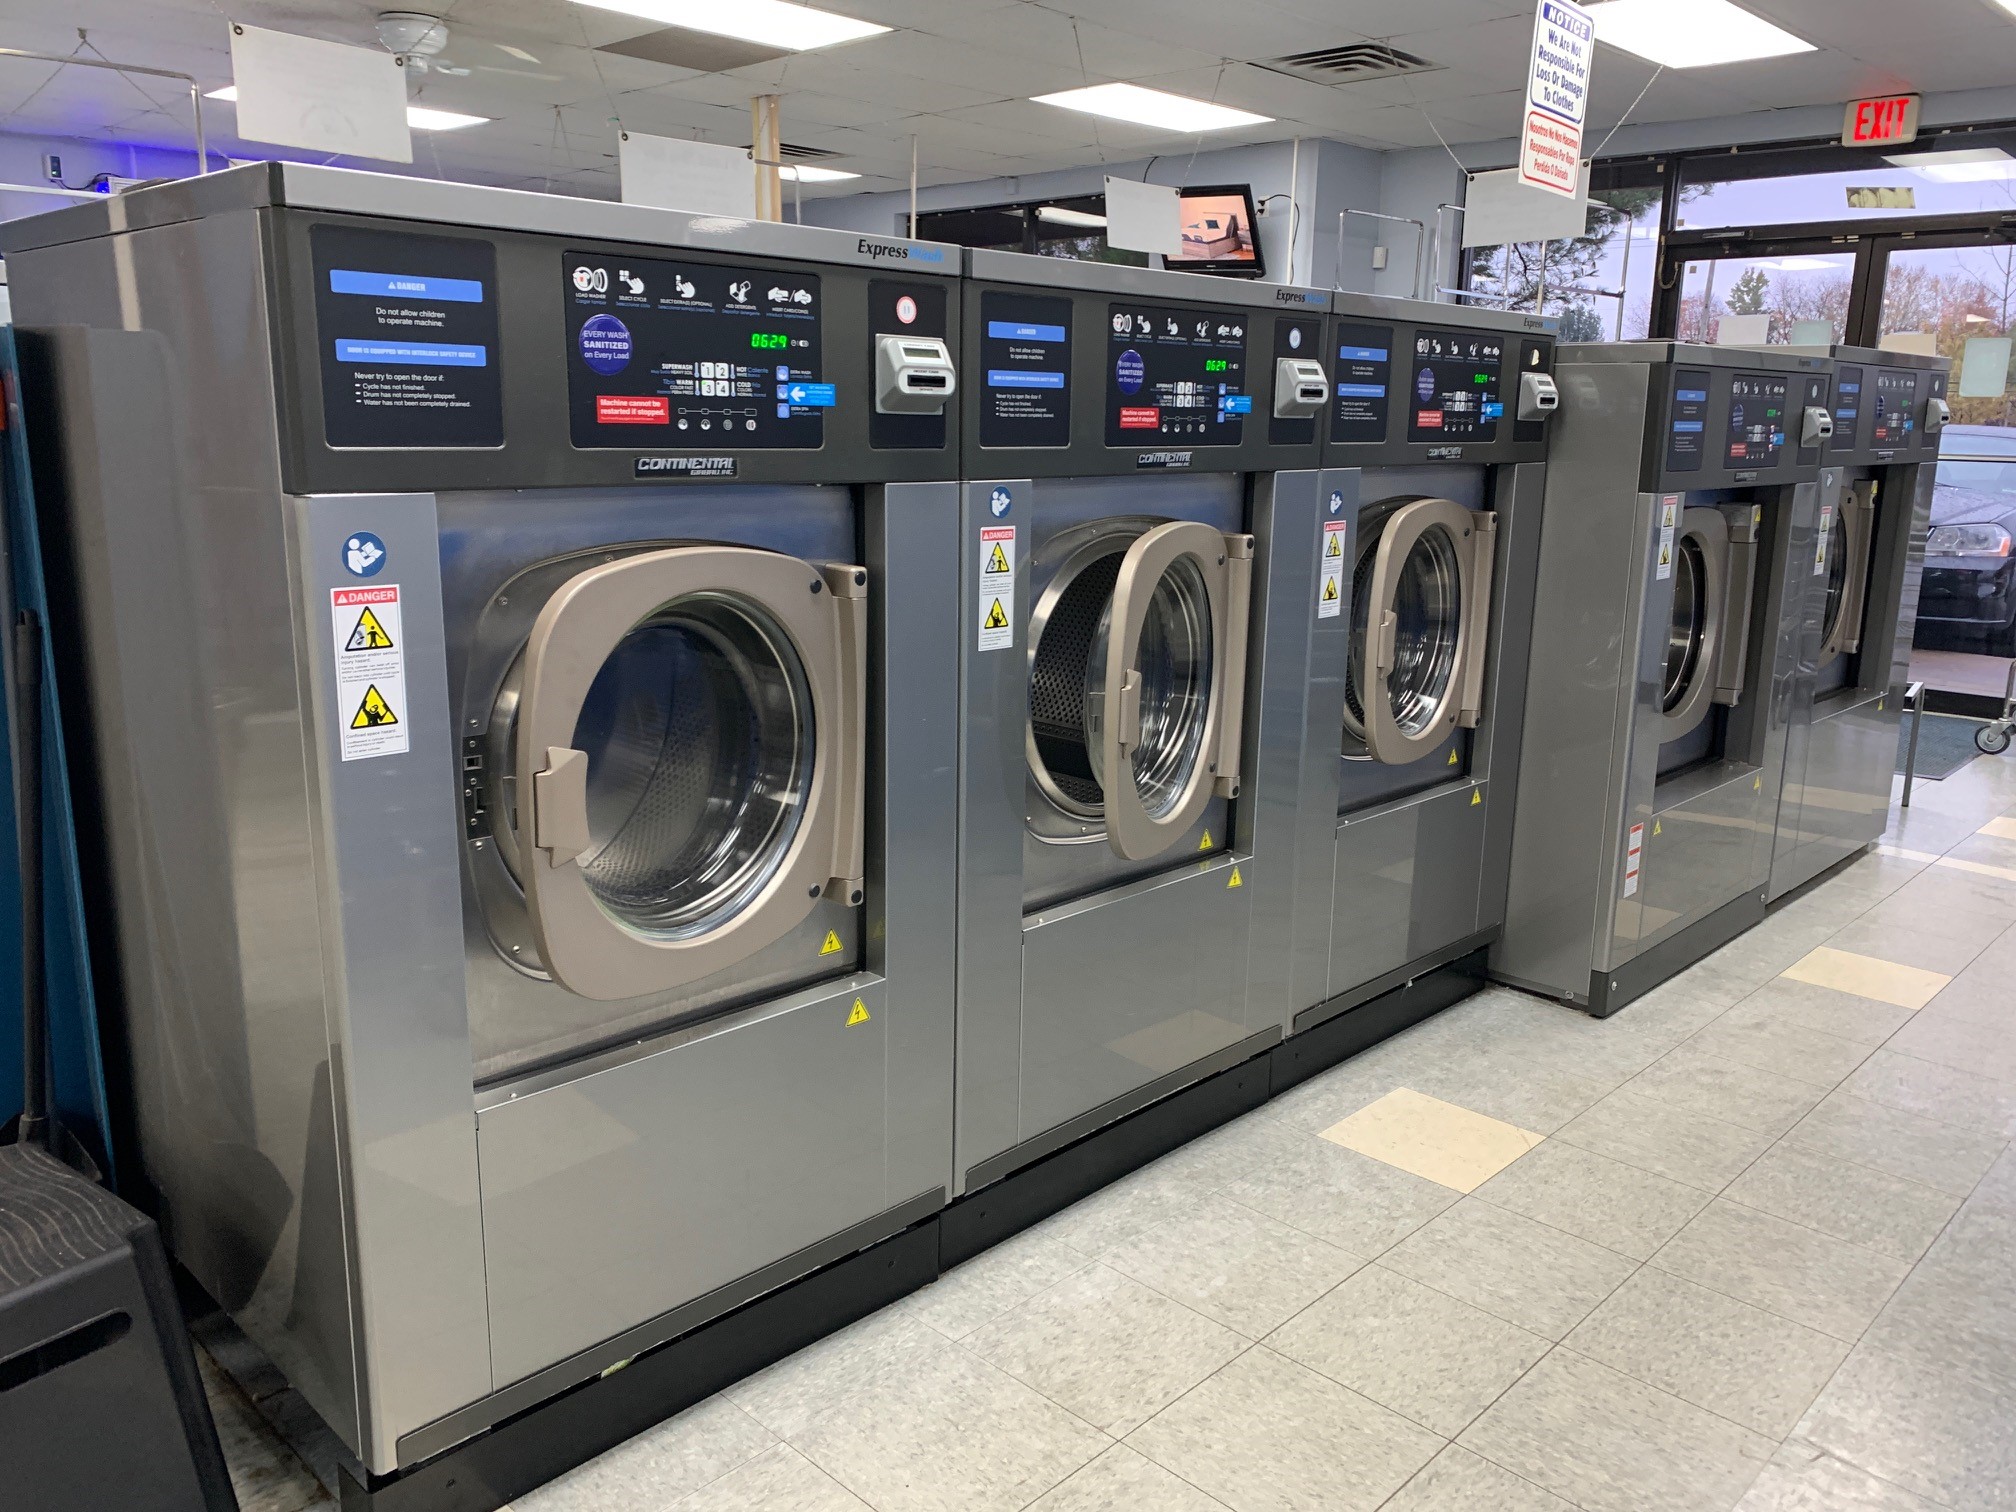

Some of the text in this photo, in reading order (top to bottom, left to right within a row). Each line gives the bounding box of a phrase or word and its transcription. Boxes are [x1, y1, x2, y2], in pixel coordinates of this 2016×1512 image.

[1548, 6, 1588, 38] NOTICE
[1548, 28, 1581, 58] We Are Not
[1538, 44, 1585, 79] Responsible For
[1536, 63, 1583, 99] Loss Or Damage
[1544, 86, 1574, 112] To Clothes
[1853, 98, 1910, 141] EXIT
[397, 281, 426, 291] DANGER
[375, 307, 386, 315] Do
[419, 310, 445, 318] children
[386, 318, 413, 326] operate
[414, 319, 444, 327] machine.
[583, 330, 628, 339] EVERY WASH
[583, 340, 629, 350] SANITIZED
[751, 333, 788, 348] 0629
[594, 351, 612, 360] Every
[661, 363, 693, 371] SUPERWASH
[1205, 360, 1227, 371] 0629
[375, 373, 385, 381] try
[637, 408, 665, 417] stopped.
[637, 457, 735, 470] CONTINENTAL
[988, 530, 1013, 540] DANGER
[349, 590, 395, 603] DANGER
